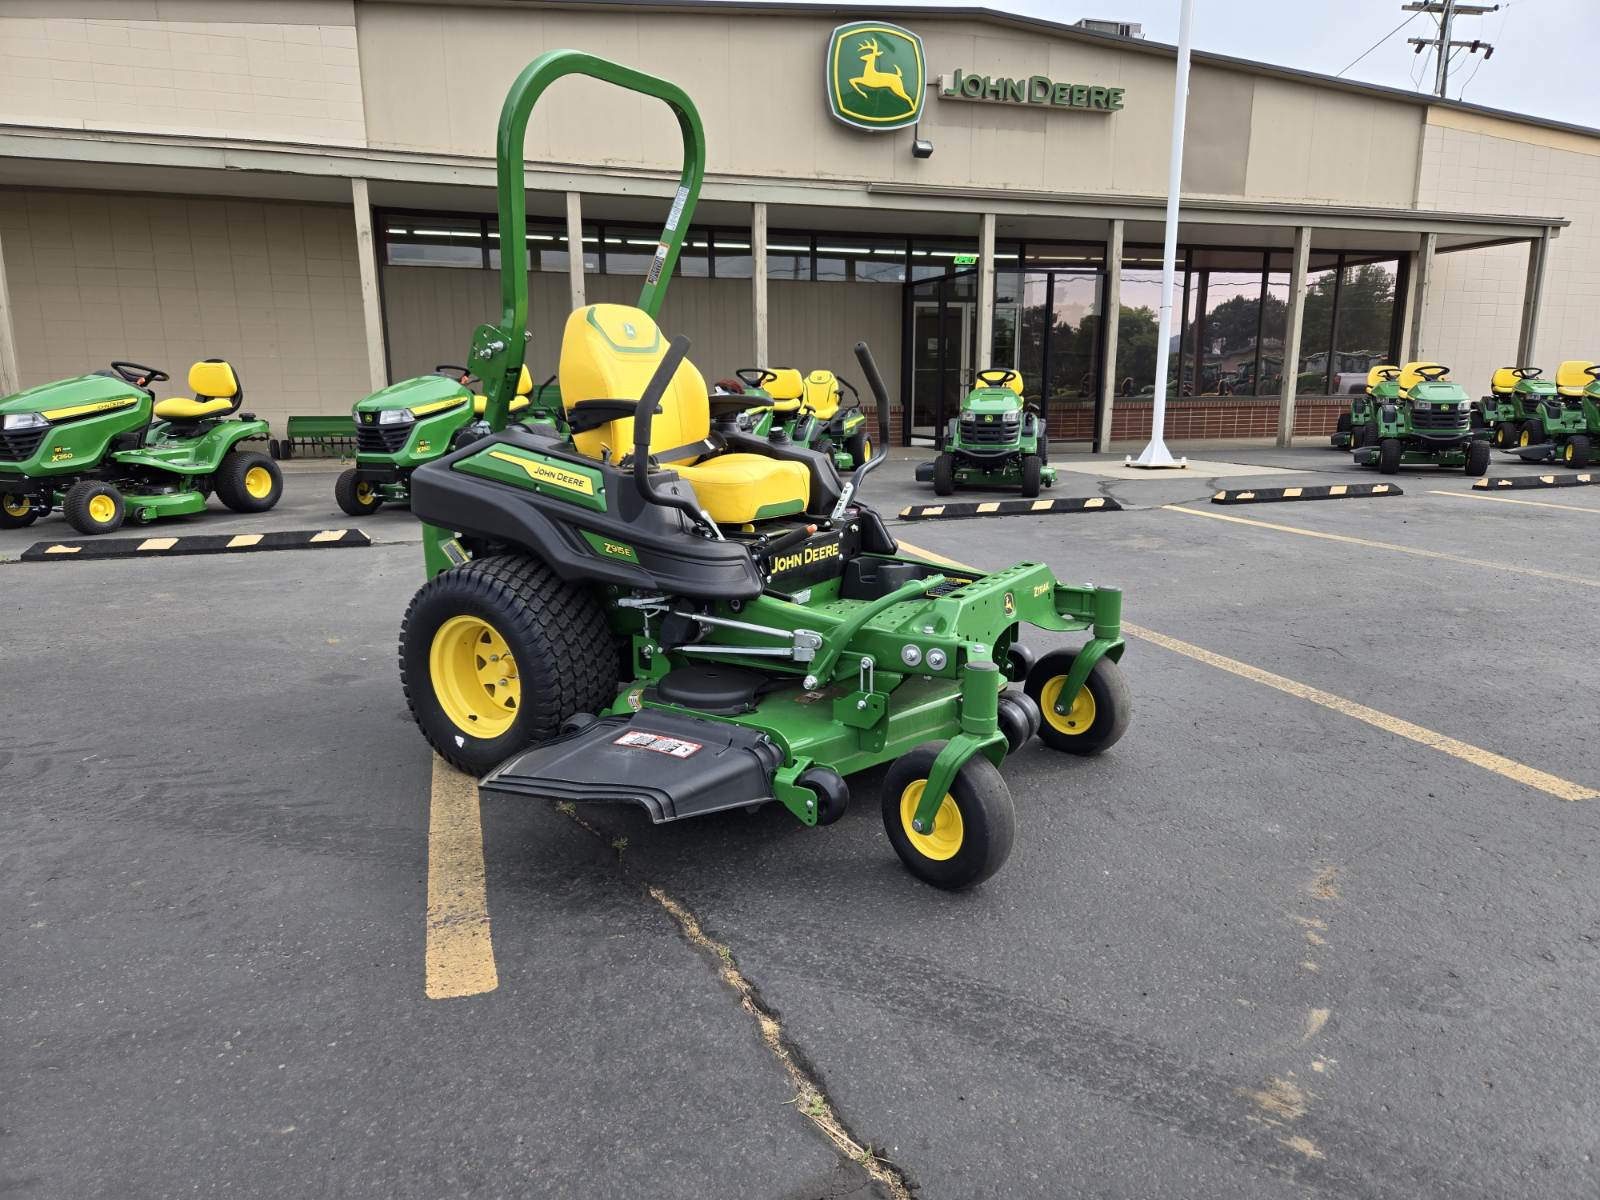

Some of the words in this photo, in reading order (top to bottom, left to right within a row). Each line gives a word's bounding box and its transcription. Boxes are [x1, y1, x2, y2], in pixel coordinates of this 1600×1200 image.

[944, 68, 1025, 103] JOHN
[1027, 75, 1125, 110] DEERE
[534, 466, 557, 479] JOHN
[556, 472, 585, 488] DEERE
[771, 553, 802, 574] JOHN
[804, 542, 839, 564] DEERE
